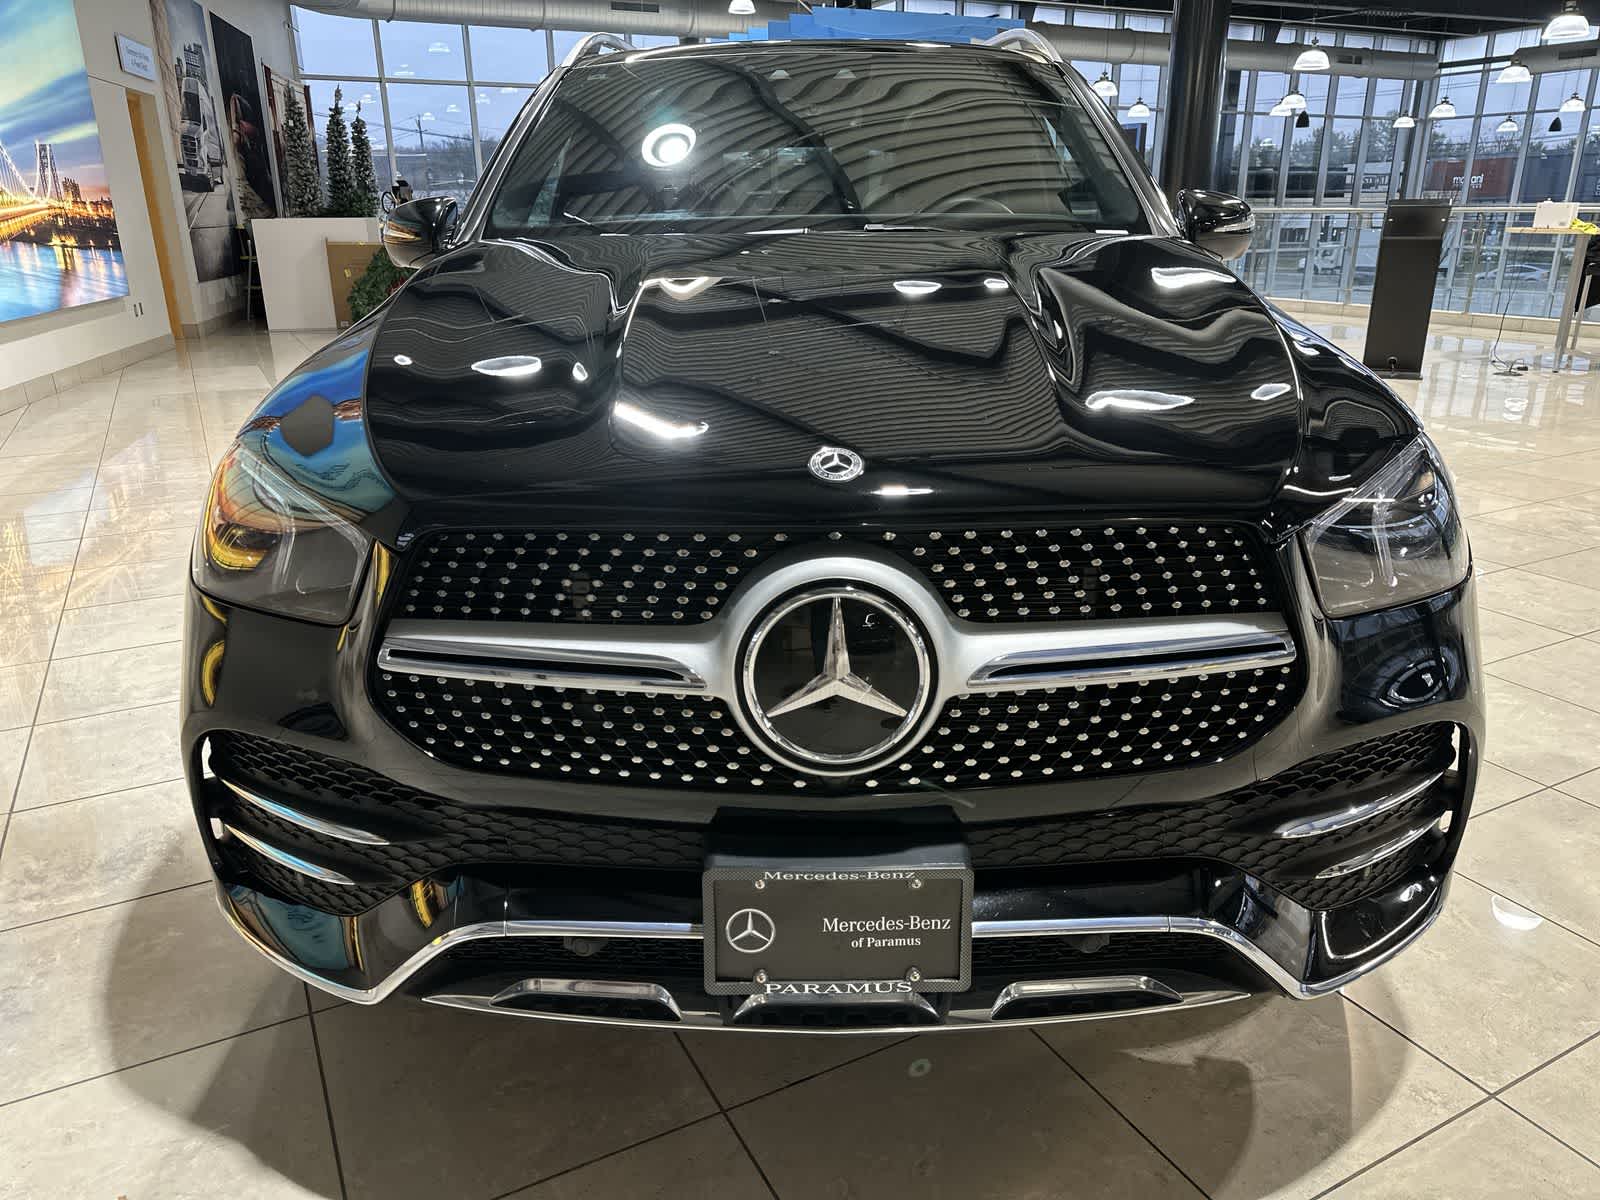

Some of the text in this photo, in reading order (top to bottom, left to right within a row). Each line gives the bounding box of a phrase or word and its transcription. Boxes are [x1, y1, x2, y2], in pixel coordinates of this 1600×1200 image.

[764, 871, 915, 881] Mercedes-Benz
[822, 915, 951, 933] Mercedes-Benz
[850, 936, 921, 949] of Paramus
[764, 981, 913, 994] PARAMUS
